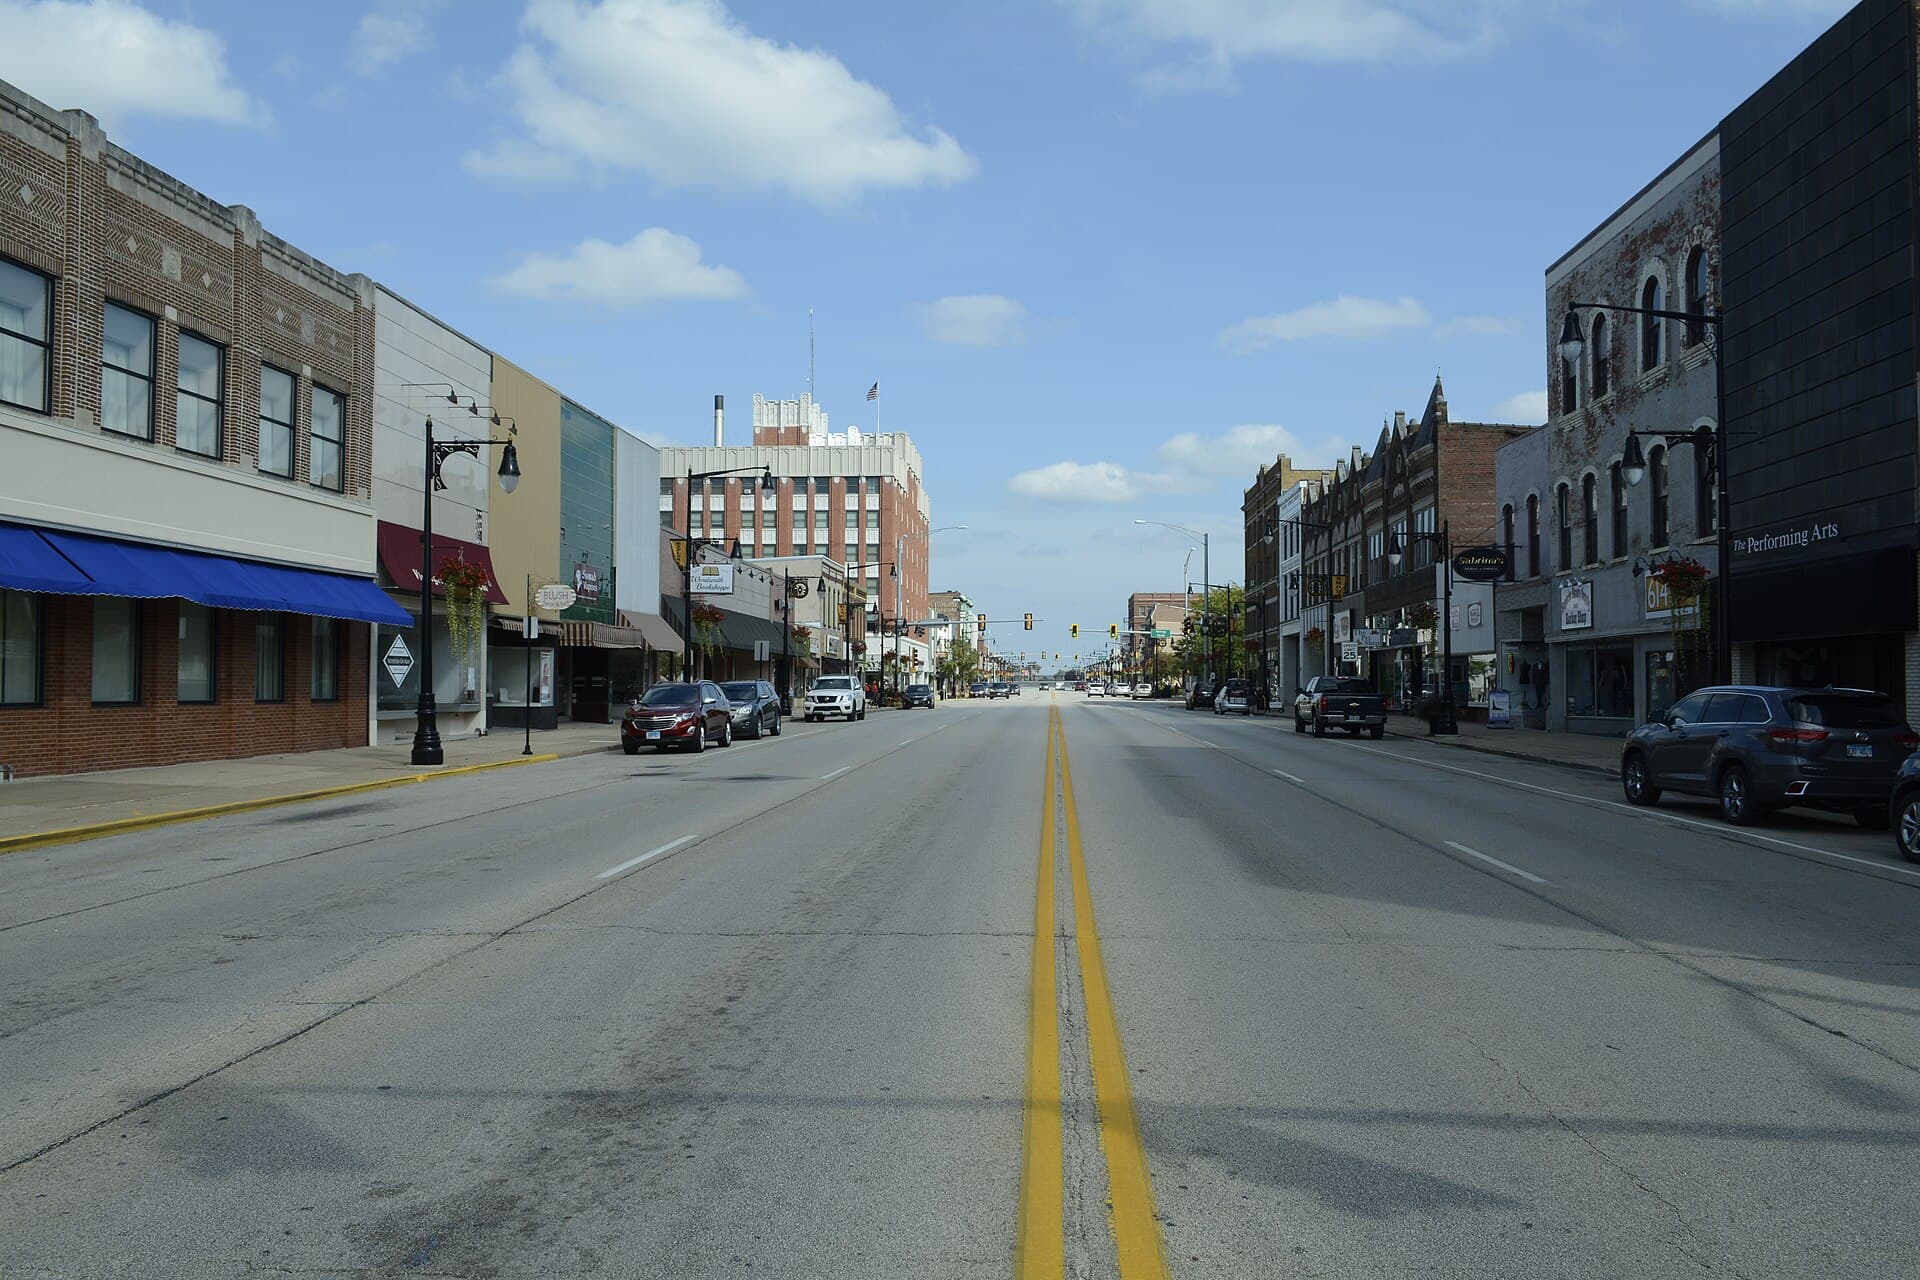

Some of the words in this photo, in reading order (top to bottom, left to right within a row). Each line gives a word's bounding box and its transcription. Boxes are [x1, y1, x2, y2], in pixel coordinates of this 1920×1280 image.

[1734, 539, 1747, 551] The
[1747, 528, 1809, 553] Performing
[1811, 522, 1839, 542] Arts
[1458, 556, 1504, 565] Sabrina's
[543, 591, 569, 600] BLUSH
[1343, 651, 1356, 660] 25
